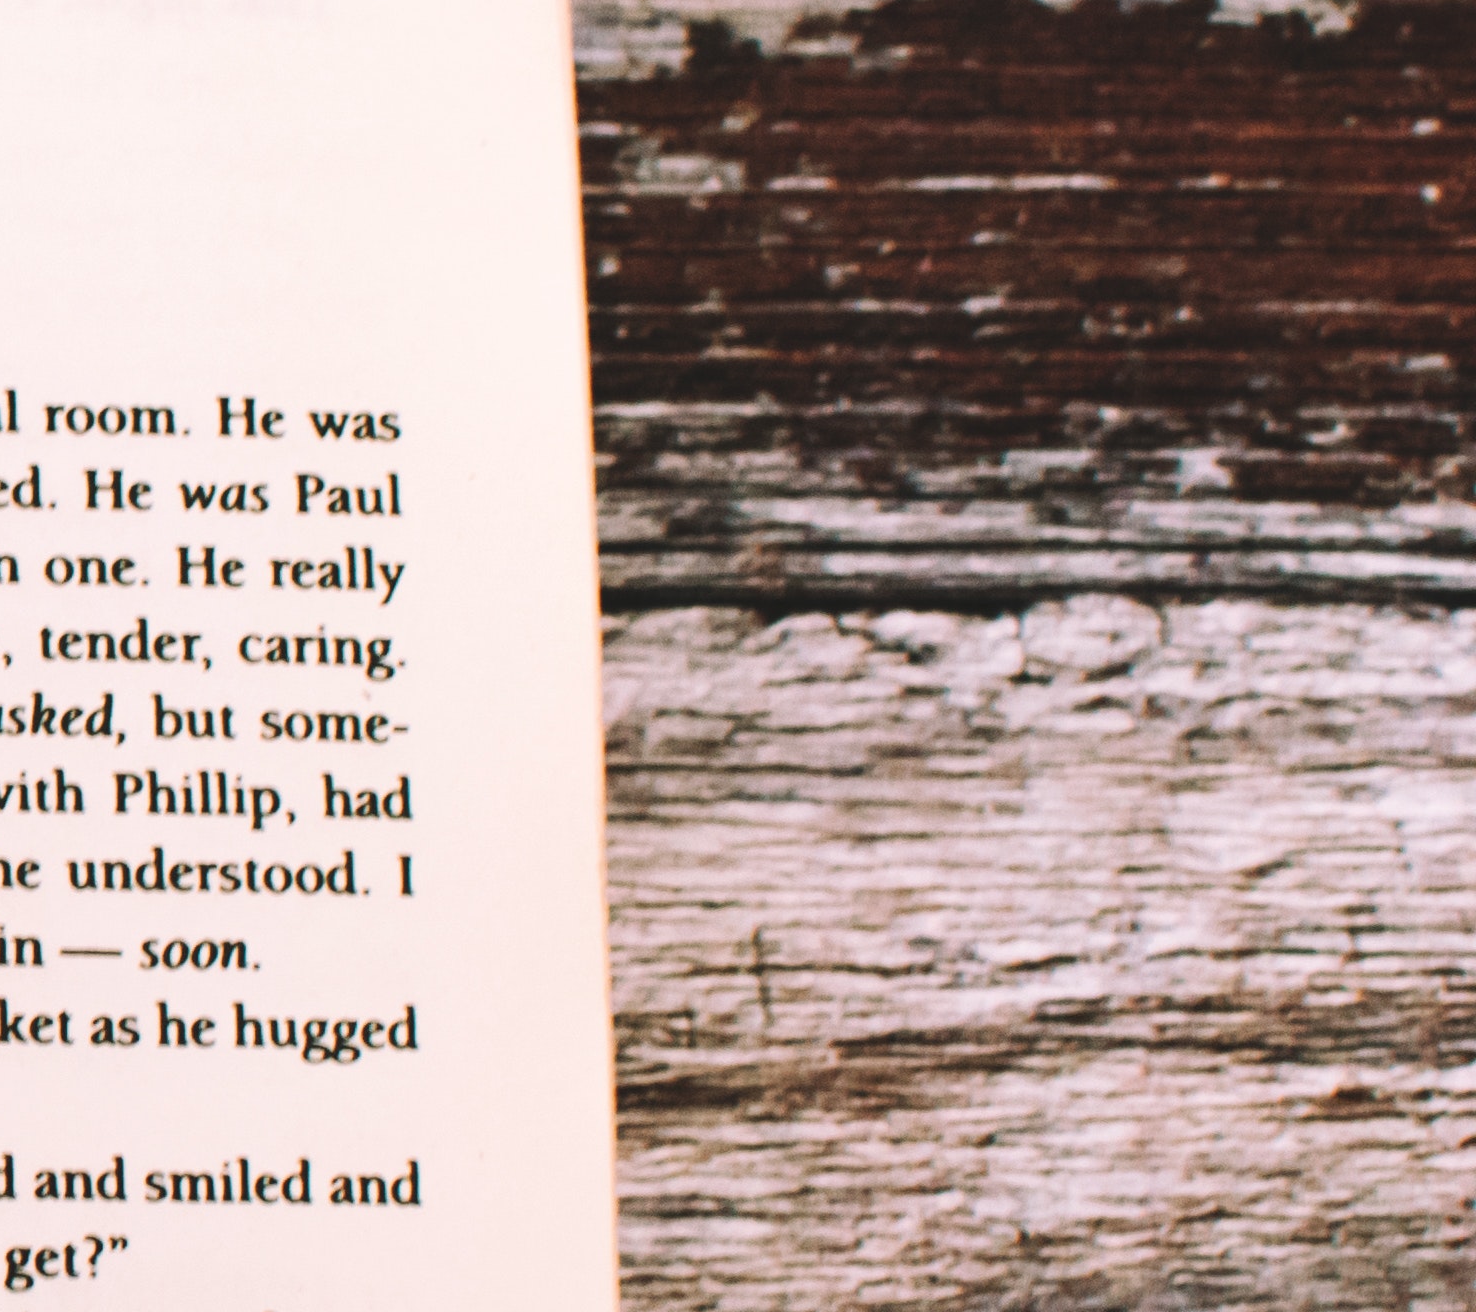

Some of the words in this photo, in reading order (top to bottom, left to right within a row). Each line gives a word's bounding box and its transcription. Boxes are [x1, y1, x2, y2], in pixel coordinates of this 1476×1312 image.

[45, 405, 190, 435] room.
[218, 396, 284, 439] He
[309, 412, 401, 442] was
[40, 617, 212, 670] tender,
[239, 626, 405, 682] caring.
[90, 1015, 140, 1047] as
[157, 1000, 215, 1048] he
[233, 1002, 418, 1064] hugged
